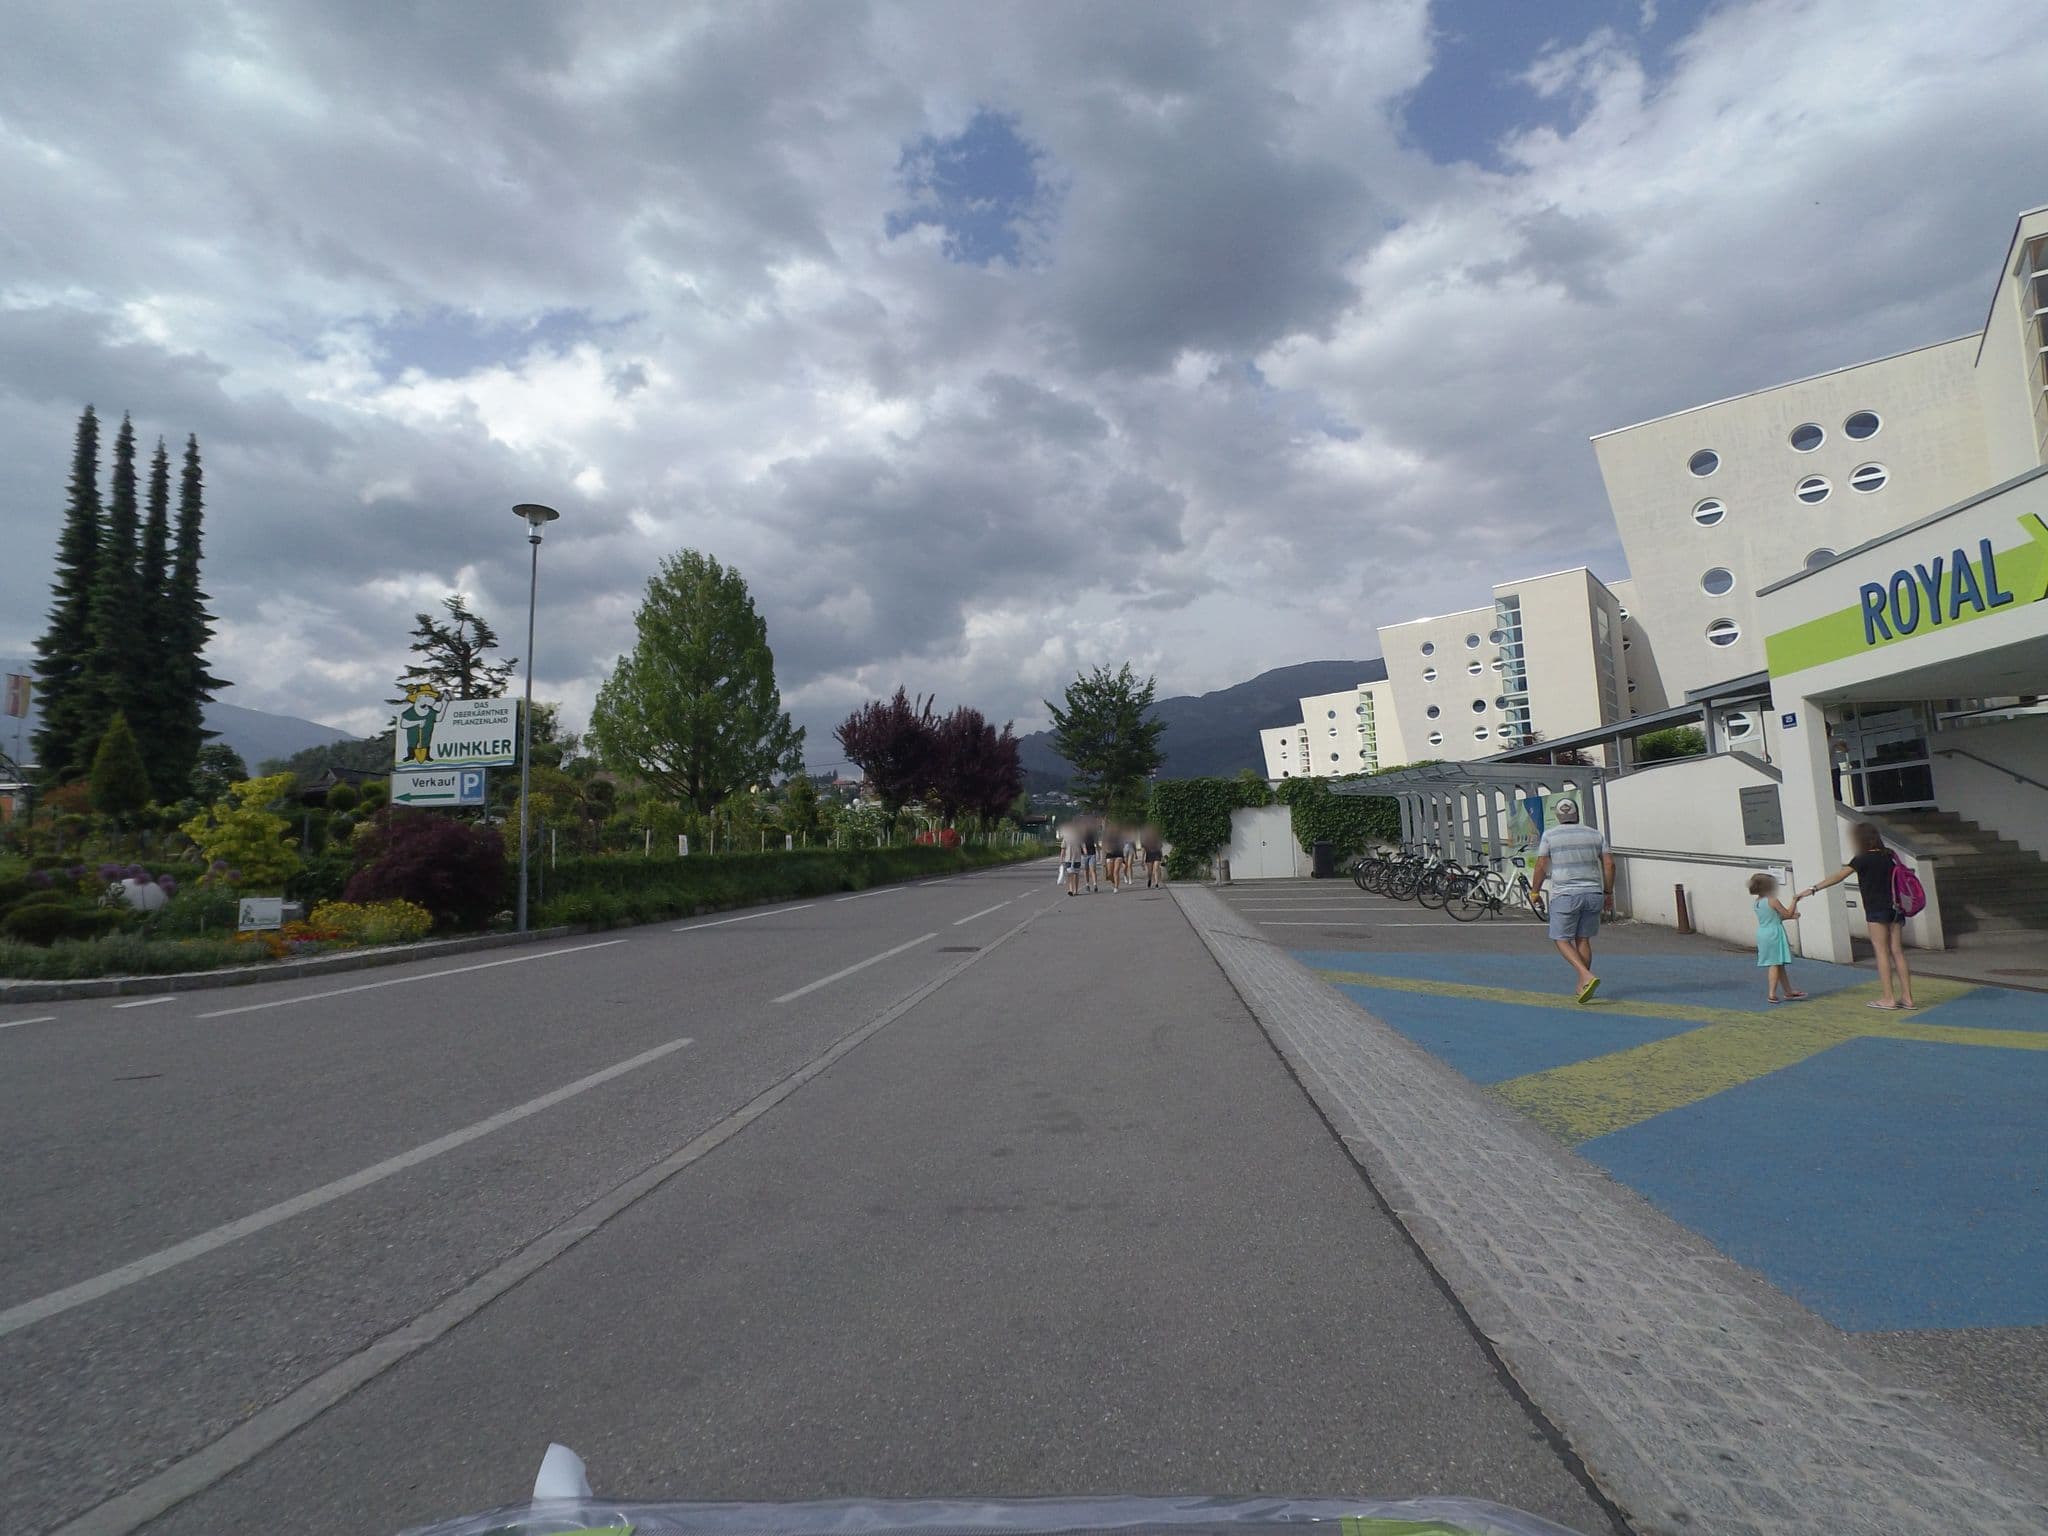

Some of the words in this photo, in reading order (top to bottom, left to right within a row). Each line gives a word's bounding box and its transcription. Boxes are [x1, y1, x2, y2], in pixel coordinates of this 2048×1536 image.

[1859, 537, 2014, 645] ROYAL
[453, 717, 508, 725] PFLANZENLAND
[437, 739, 512, 758] WINKLER
[412, 776, 456, 788] Verkauf
[463, 773, 480, 795] P
